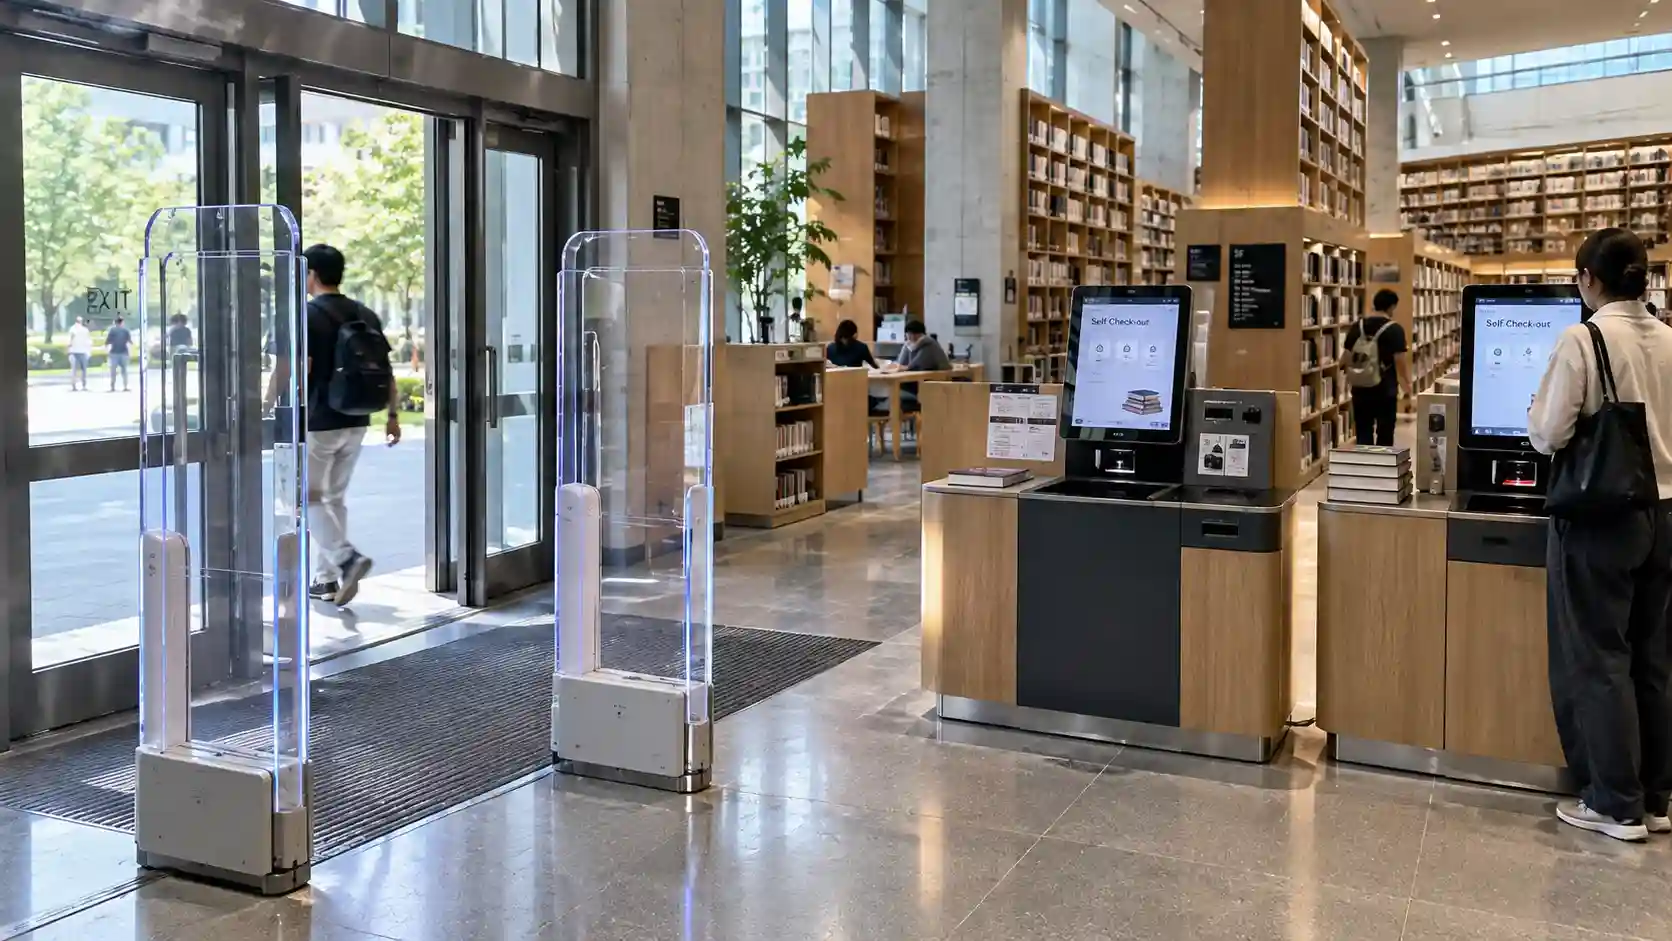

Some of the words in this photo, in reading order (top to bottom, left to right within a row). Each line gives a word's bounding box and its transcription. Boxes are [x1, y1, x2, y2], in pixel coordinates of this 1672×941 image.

[1091, 317, 1107, 326] Self
[1108, 317, 1150, 327] Check-out
[1505, 319, 1551, 329] Check-out
